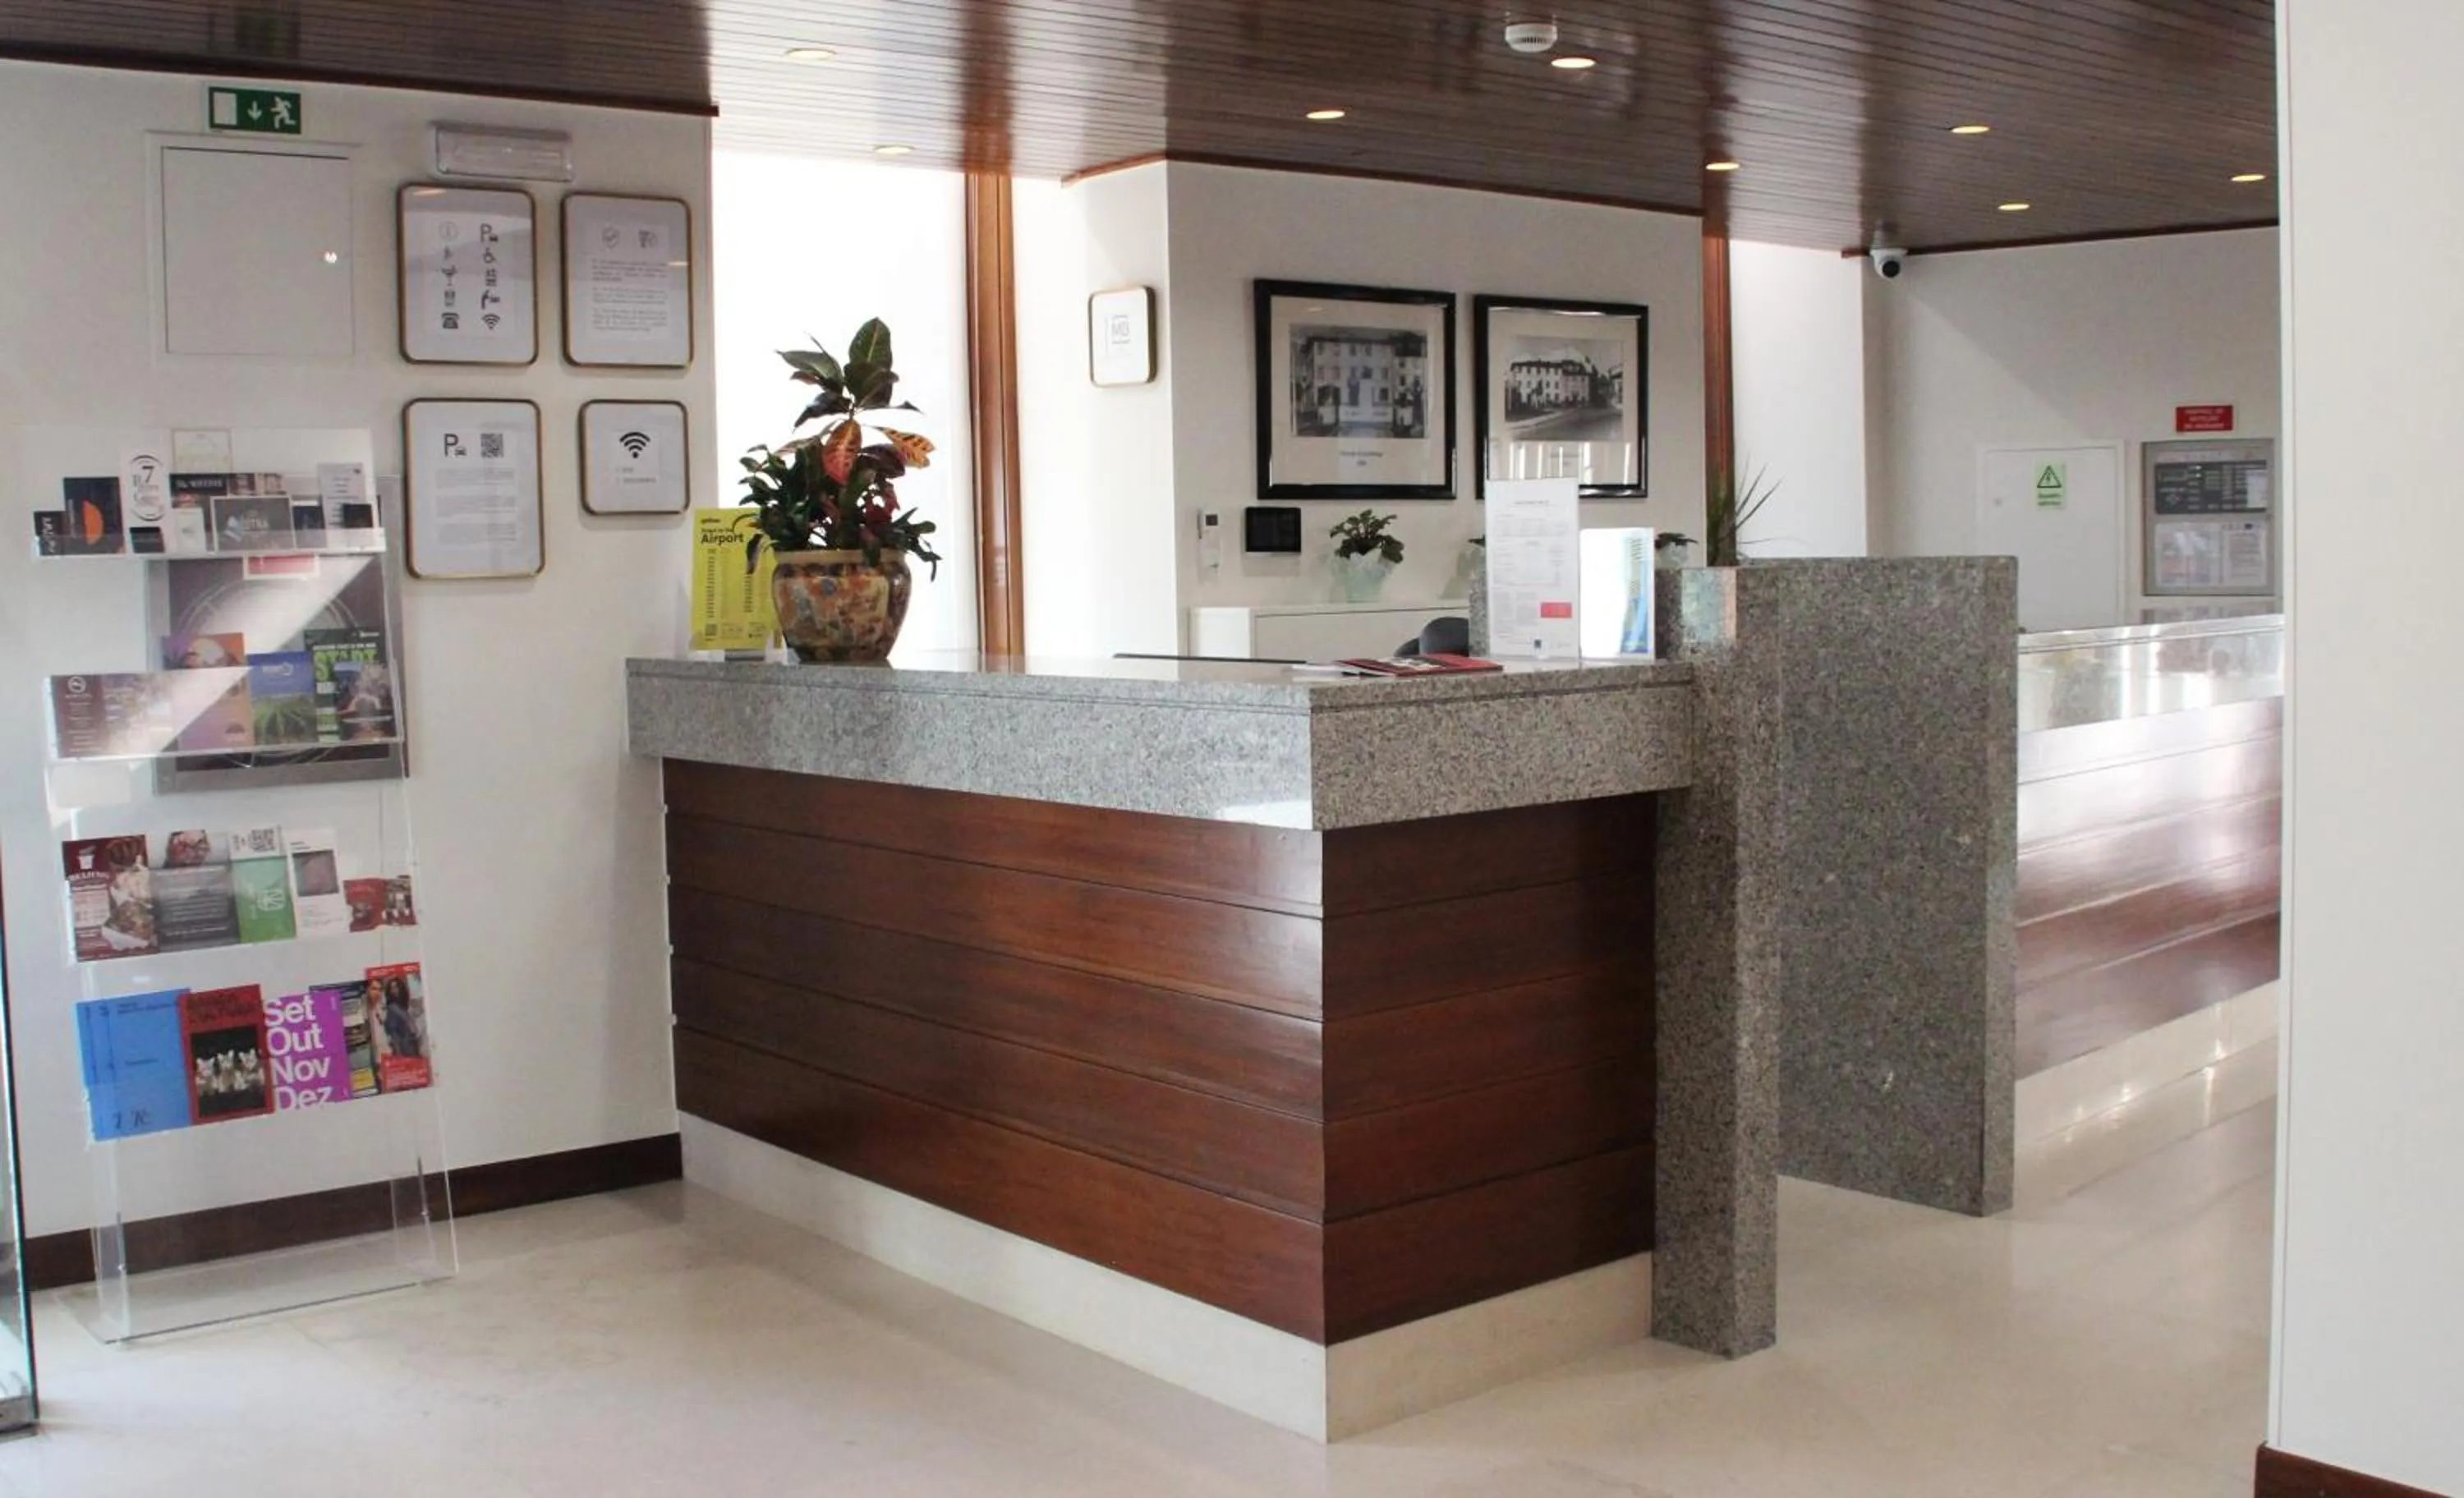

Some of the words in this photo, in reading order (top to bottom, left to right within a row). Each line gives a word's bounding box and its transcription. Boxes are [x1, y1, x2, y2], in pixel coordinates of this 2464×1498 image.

[701, 532, 744, 548] Airport
[264, 995, 316, 1027] Set
[266, 1023, 324, 1056] Out
[269, 1055, 331, 1085] Nov
[274, 1086, 333, 1110] Dez
